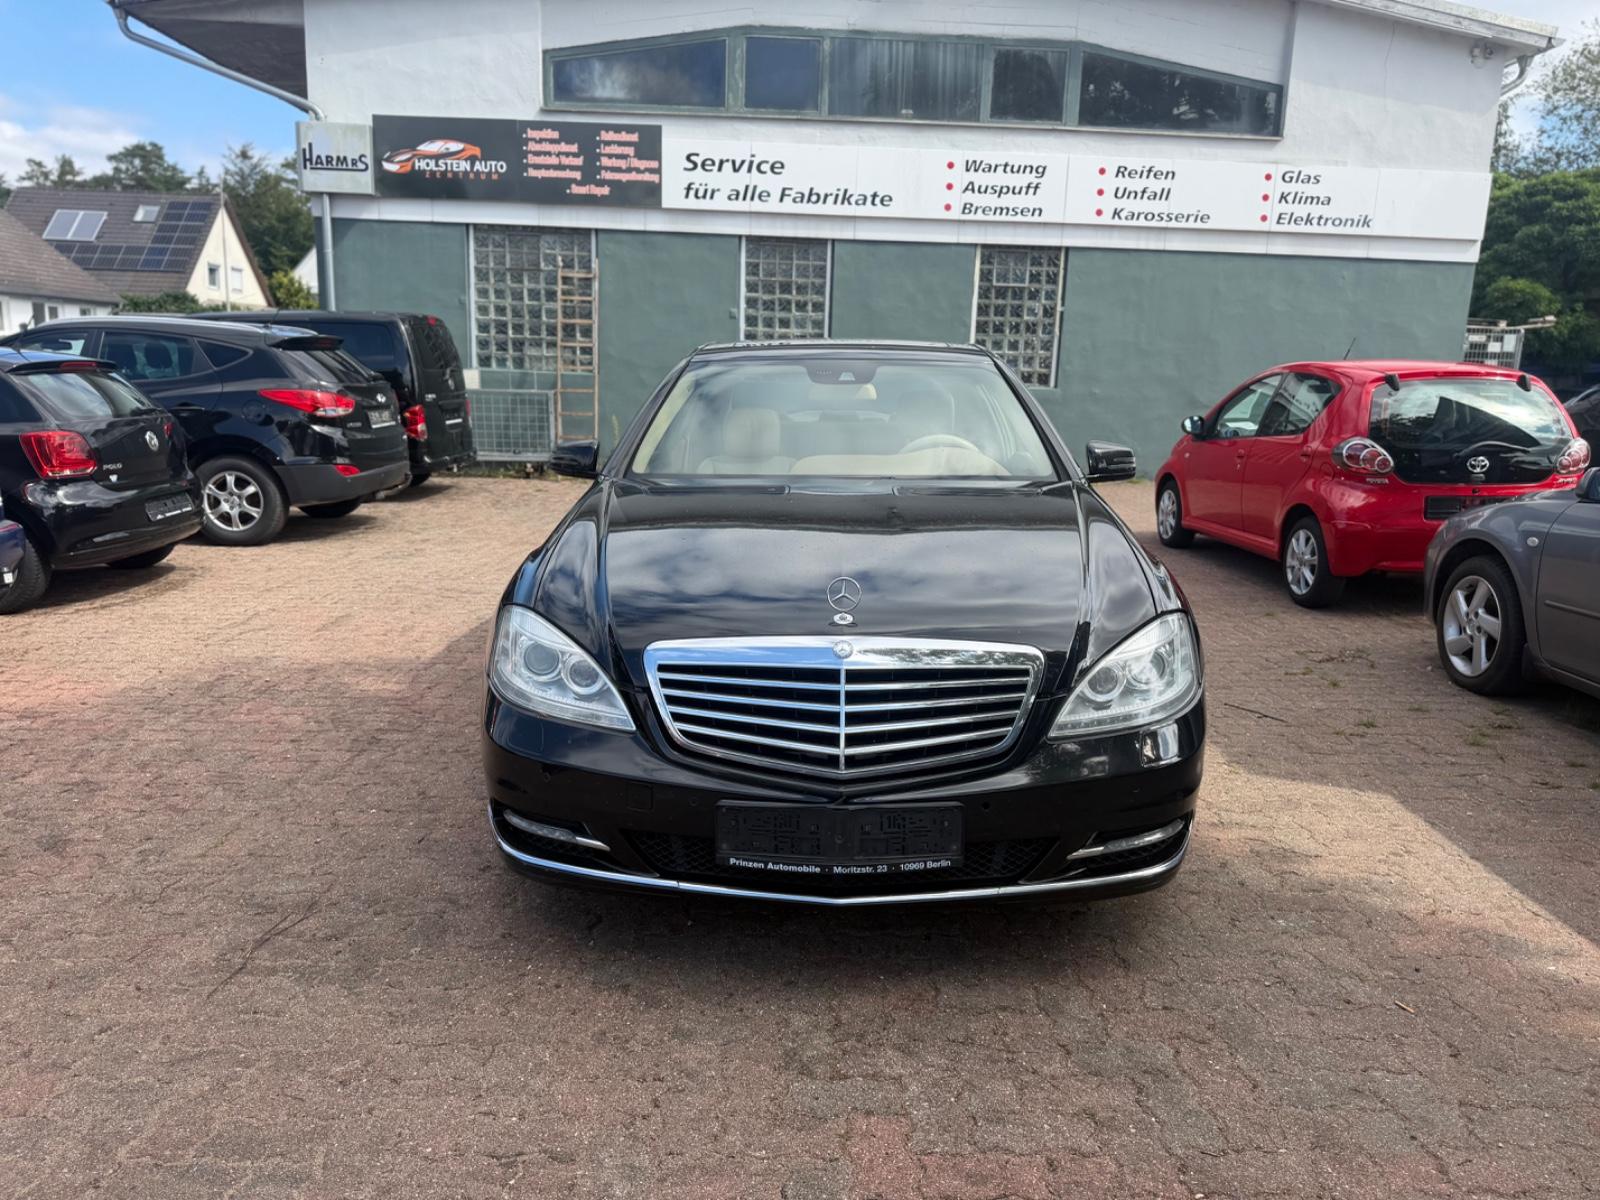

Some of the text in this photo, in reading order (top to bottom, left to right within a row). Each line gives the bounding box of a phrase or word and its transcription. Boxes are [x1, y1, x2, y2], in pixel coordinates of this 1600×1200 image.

[415, 158, 507, 173] HOLSTEIN AUTO
[683, 152, 785, 175] Service
[964, 159, 1047, 178] Wartung
[1114, 165, 1176, 181] Reifen
[1281, 170, 1322, 185] Glas
[683, 182, 893, 207] für alle Fabrikate
[962, 180, 1042, 199] Auspuff
[1113, 186, 1171, 202] Unfall
[1278, 191, 1332, 207] Klima
[961, 202, 1044, 218] Bremsen
[1111, 207, 1211, 225] Karosserie
[1276, 212, 1373, 229] Elektronik
[729, 858, 951, 874] Prinzen Automobile Moritzstr. 23 10969 Berlin
